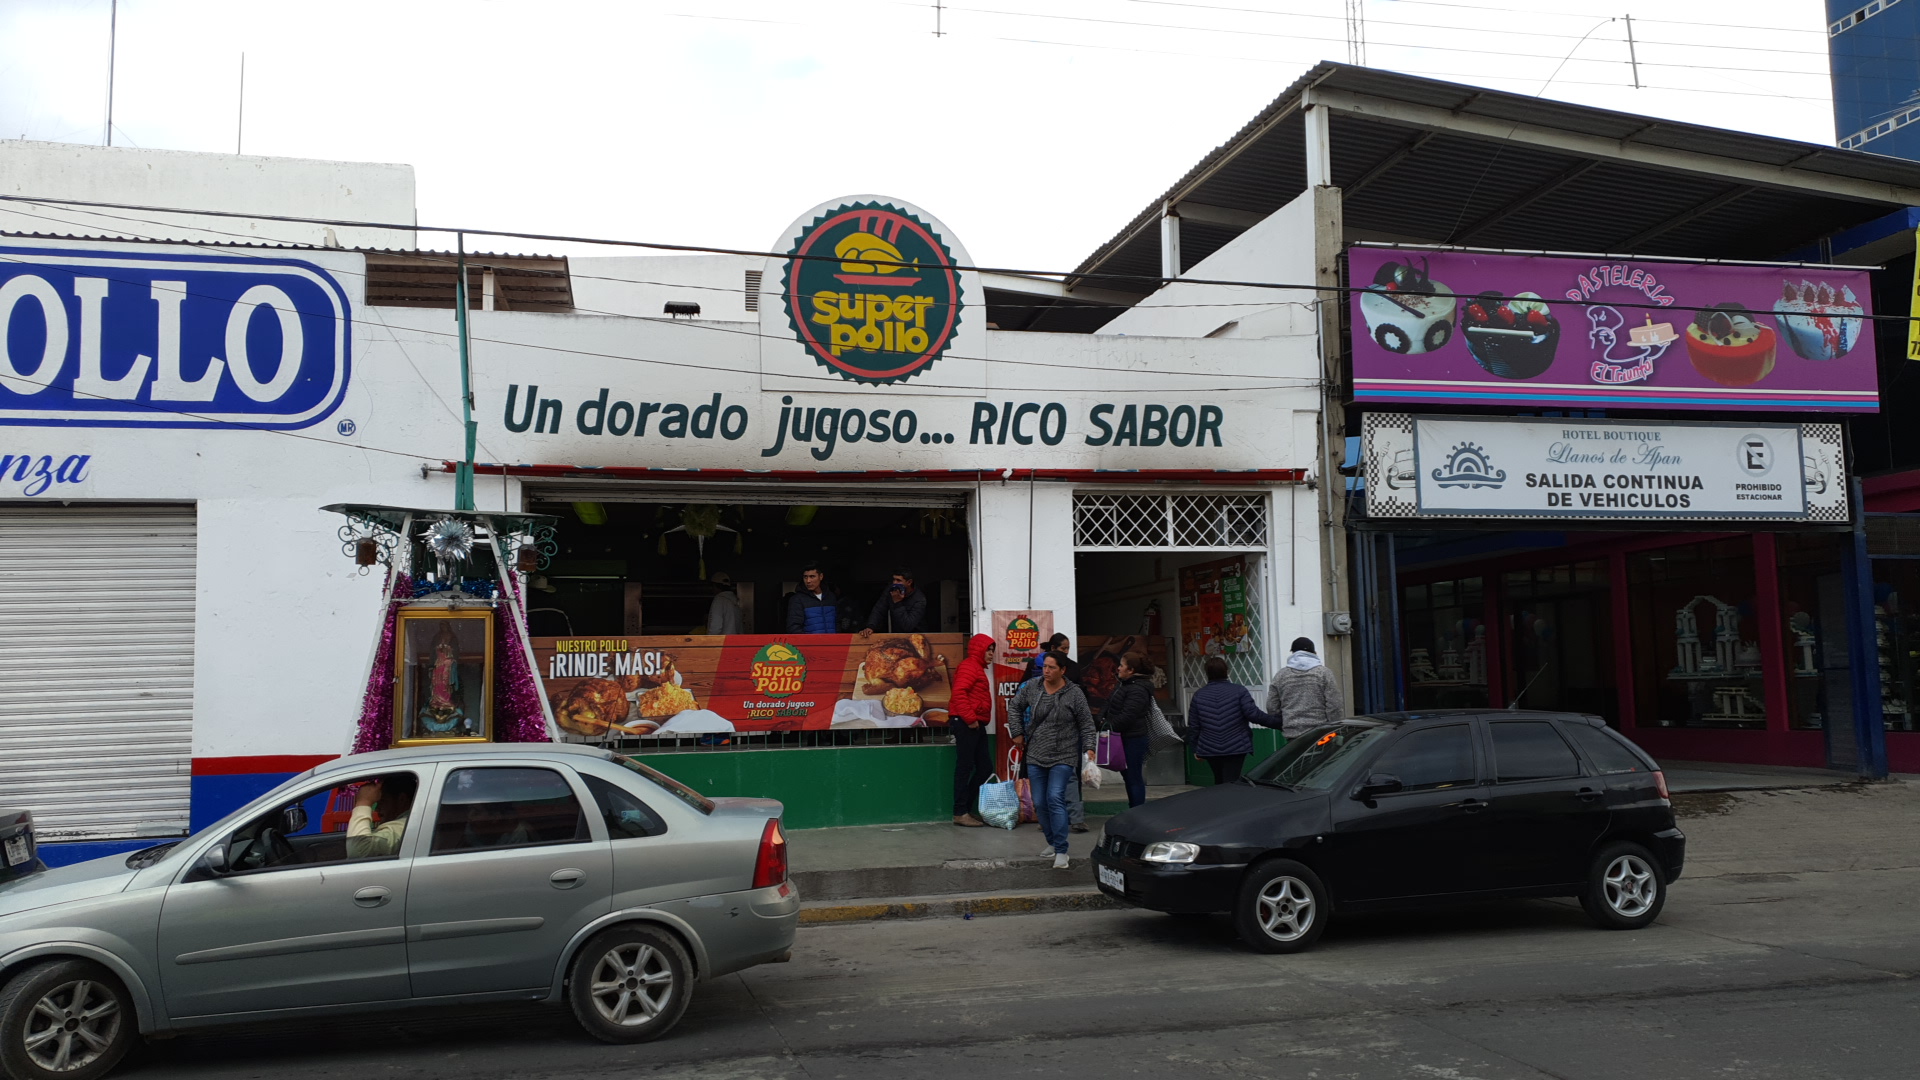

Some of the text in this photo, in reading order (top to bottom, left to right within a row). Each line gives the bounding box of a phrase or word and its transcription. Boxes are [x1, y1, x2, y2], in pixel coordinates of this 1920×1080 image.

[504, 384, 1223, 461] Un dorado jugoso... RICO SABOR
[1562, 430, 1661, 442] HOTEL BOUTIQUE
[1609, 448, 1627, 464] de
[1632, 443, 1682, 471] Apan
[1525, 473, 1704, 490] SALIDA CONTINUA
[1735, 483, 1782, 491] PROHIBIDO
[1547, 492, 1691, 508] DE VEHICULOS
[1214, 580, 1220, 594] 2
[1007, 630, 1038, 643] Super
[1010, 638, 1037, 648] Pollo
[556, 640, 628, 652] NUESTRO POLLO
[549, 649, 661, 680] ¡RINDE MÁS!
[752, 663, 803, 680] Super
[756, 678, 802, 691] Pollo
[787, 701, 815, 709] jugoso
